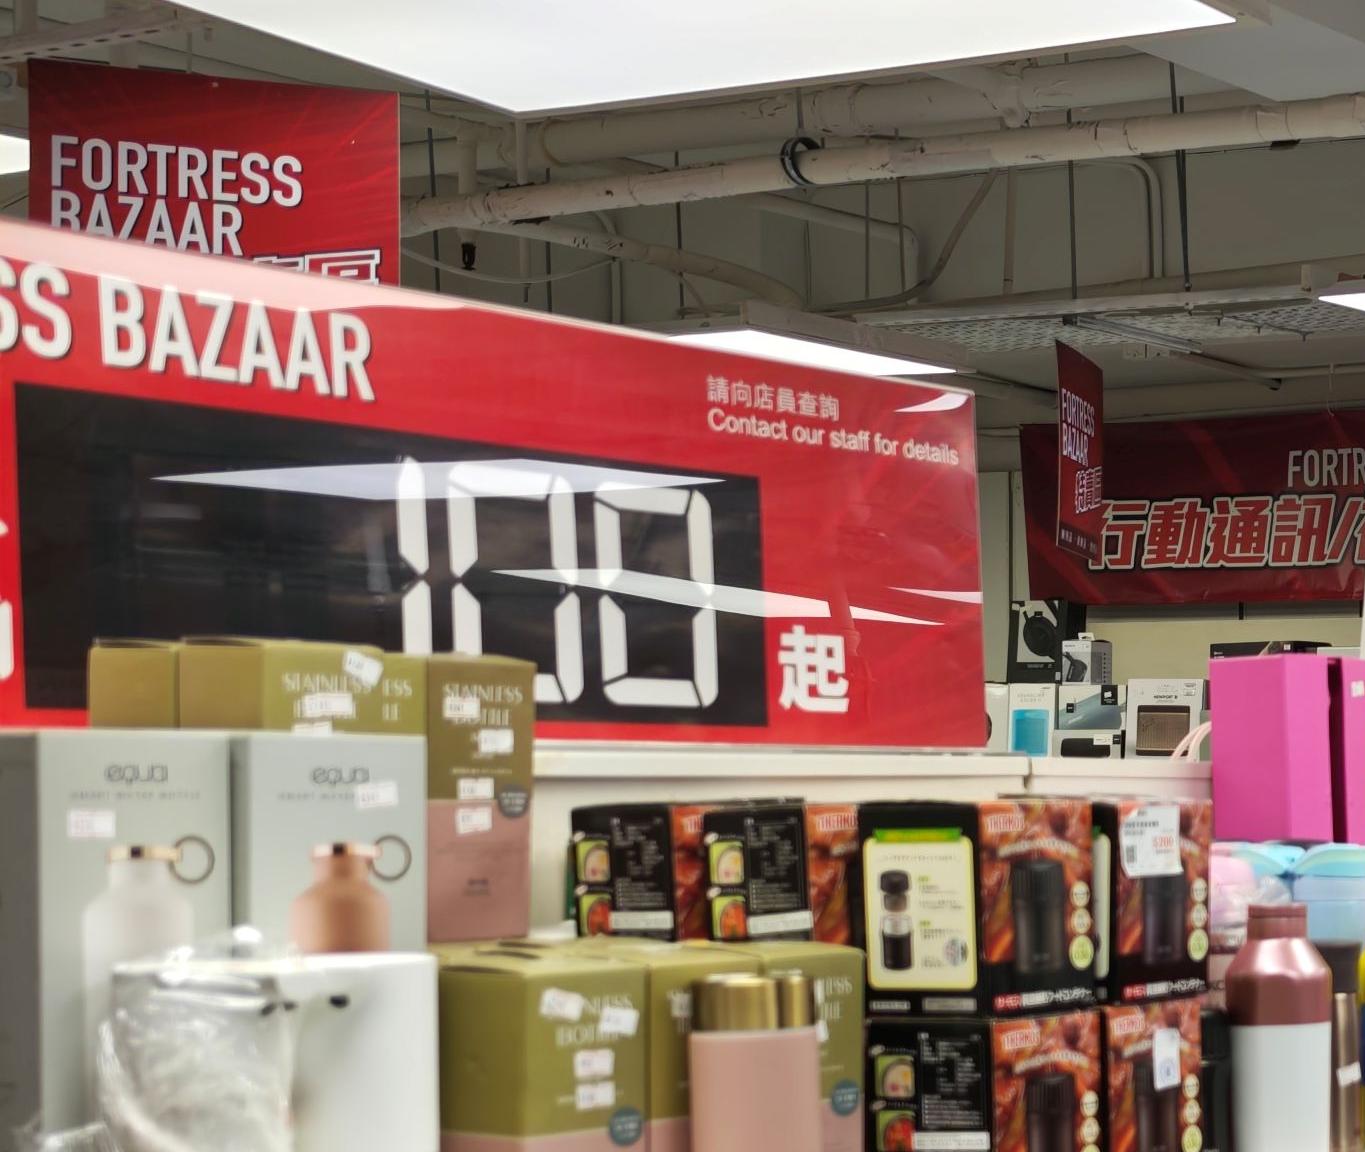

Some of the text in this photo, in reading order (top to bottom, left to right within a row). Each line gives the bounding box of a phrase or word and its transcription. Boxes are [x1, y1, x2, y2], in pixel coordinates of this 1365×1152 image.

[51, 134, 303, 207] FORTRESS
[51, 190, 243, 256] BAZAAR
[98, 272, 375, 402] BAZAAR
[706, 375, 839, 421] 請向店員查詢
[1061, 388, 1095, 437] FORTRESS
[707, 407, 960, 465] Contact our staff for details
[1062, 422, 1089, 467] BAZAAR
[443, 684, 523, 705] STAINLESS
[778, 623, 850, 714] 起
